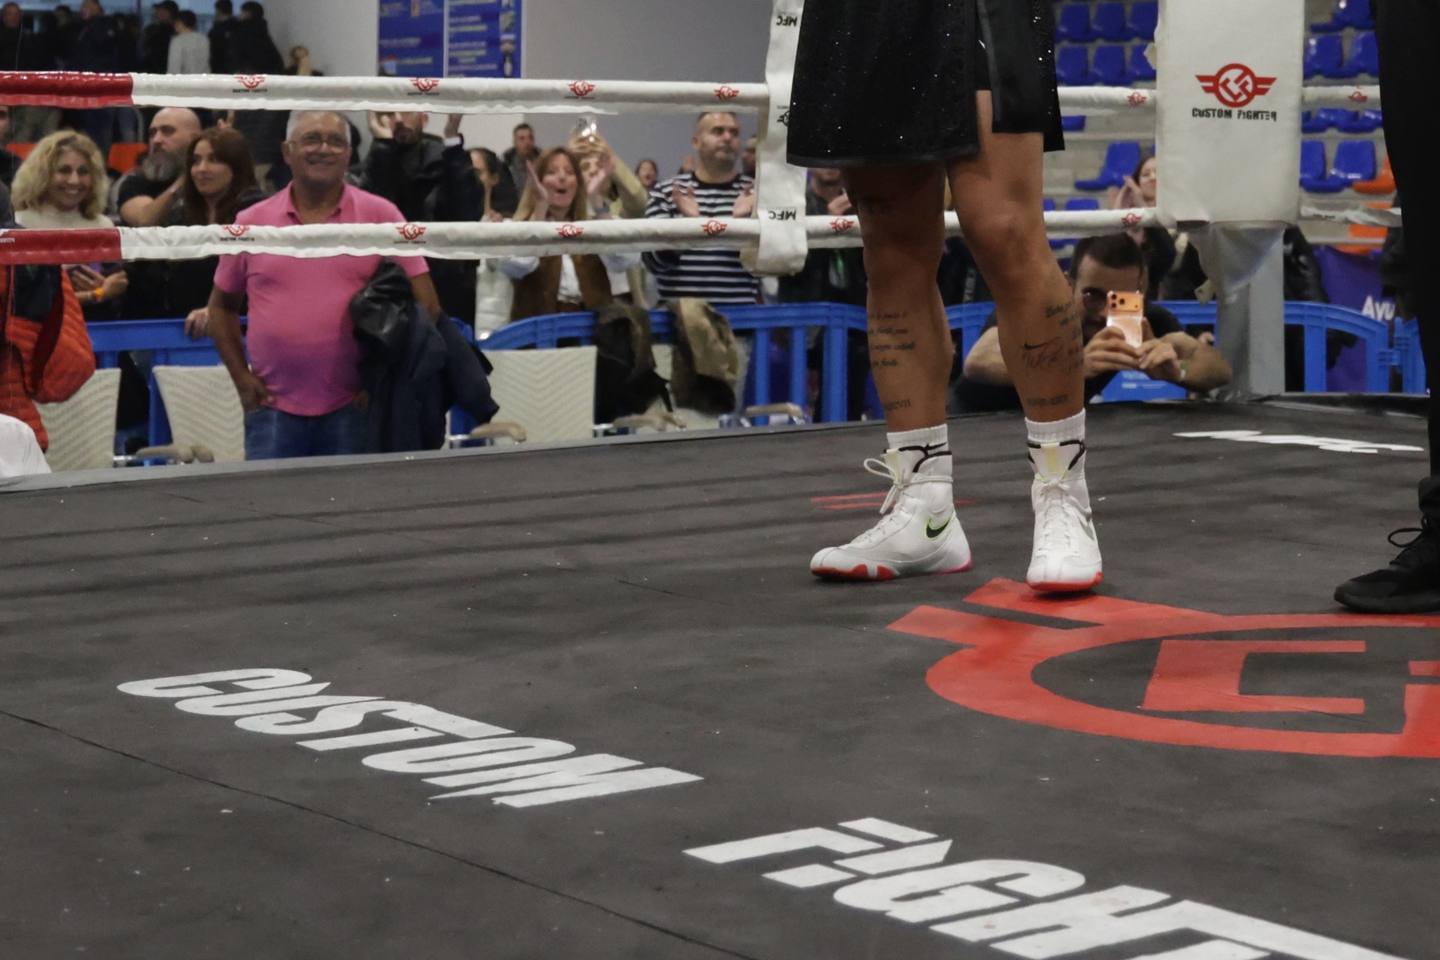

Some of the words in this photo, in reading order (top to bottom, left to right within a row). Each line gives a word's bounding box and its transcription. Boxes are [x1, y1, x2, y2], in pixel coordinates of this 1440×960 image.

[776, 14, 798, 27] MFC
[1191, 107, 1232, 119] CUSTOM
[767, 209, 797, 221] MFC
[116, 667, 705, 809] CUSTOM
